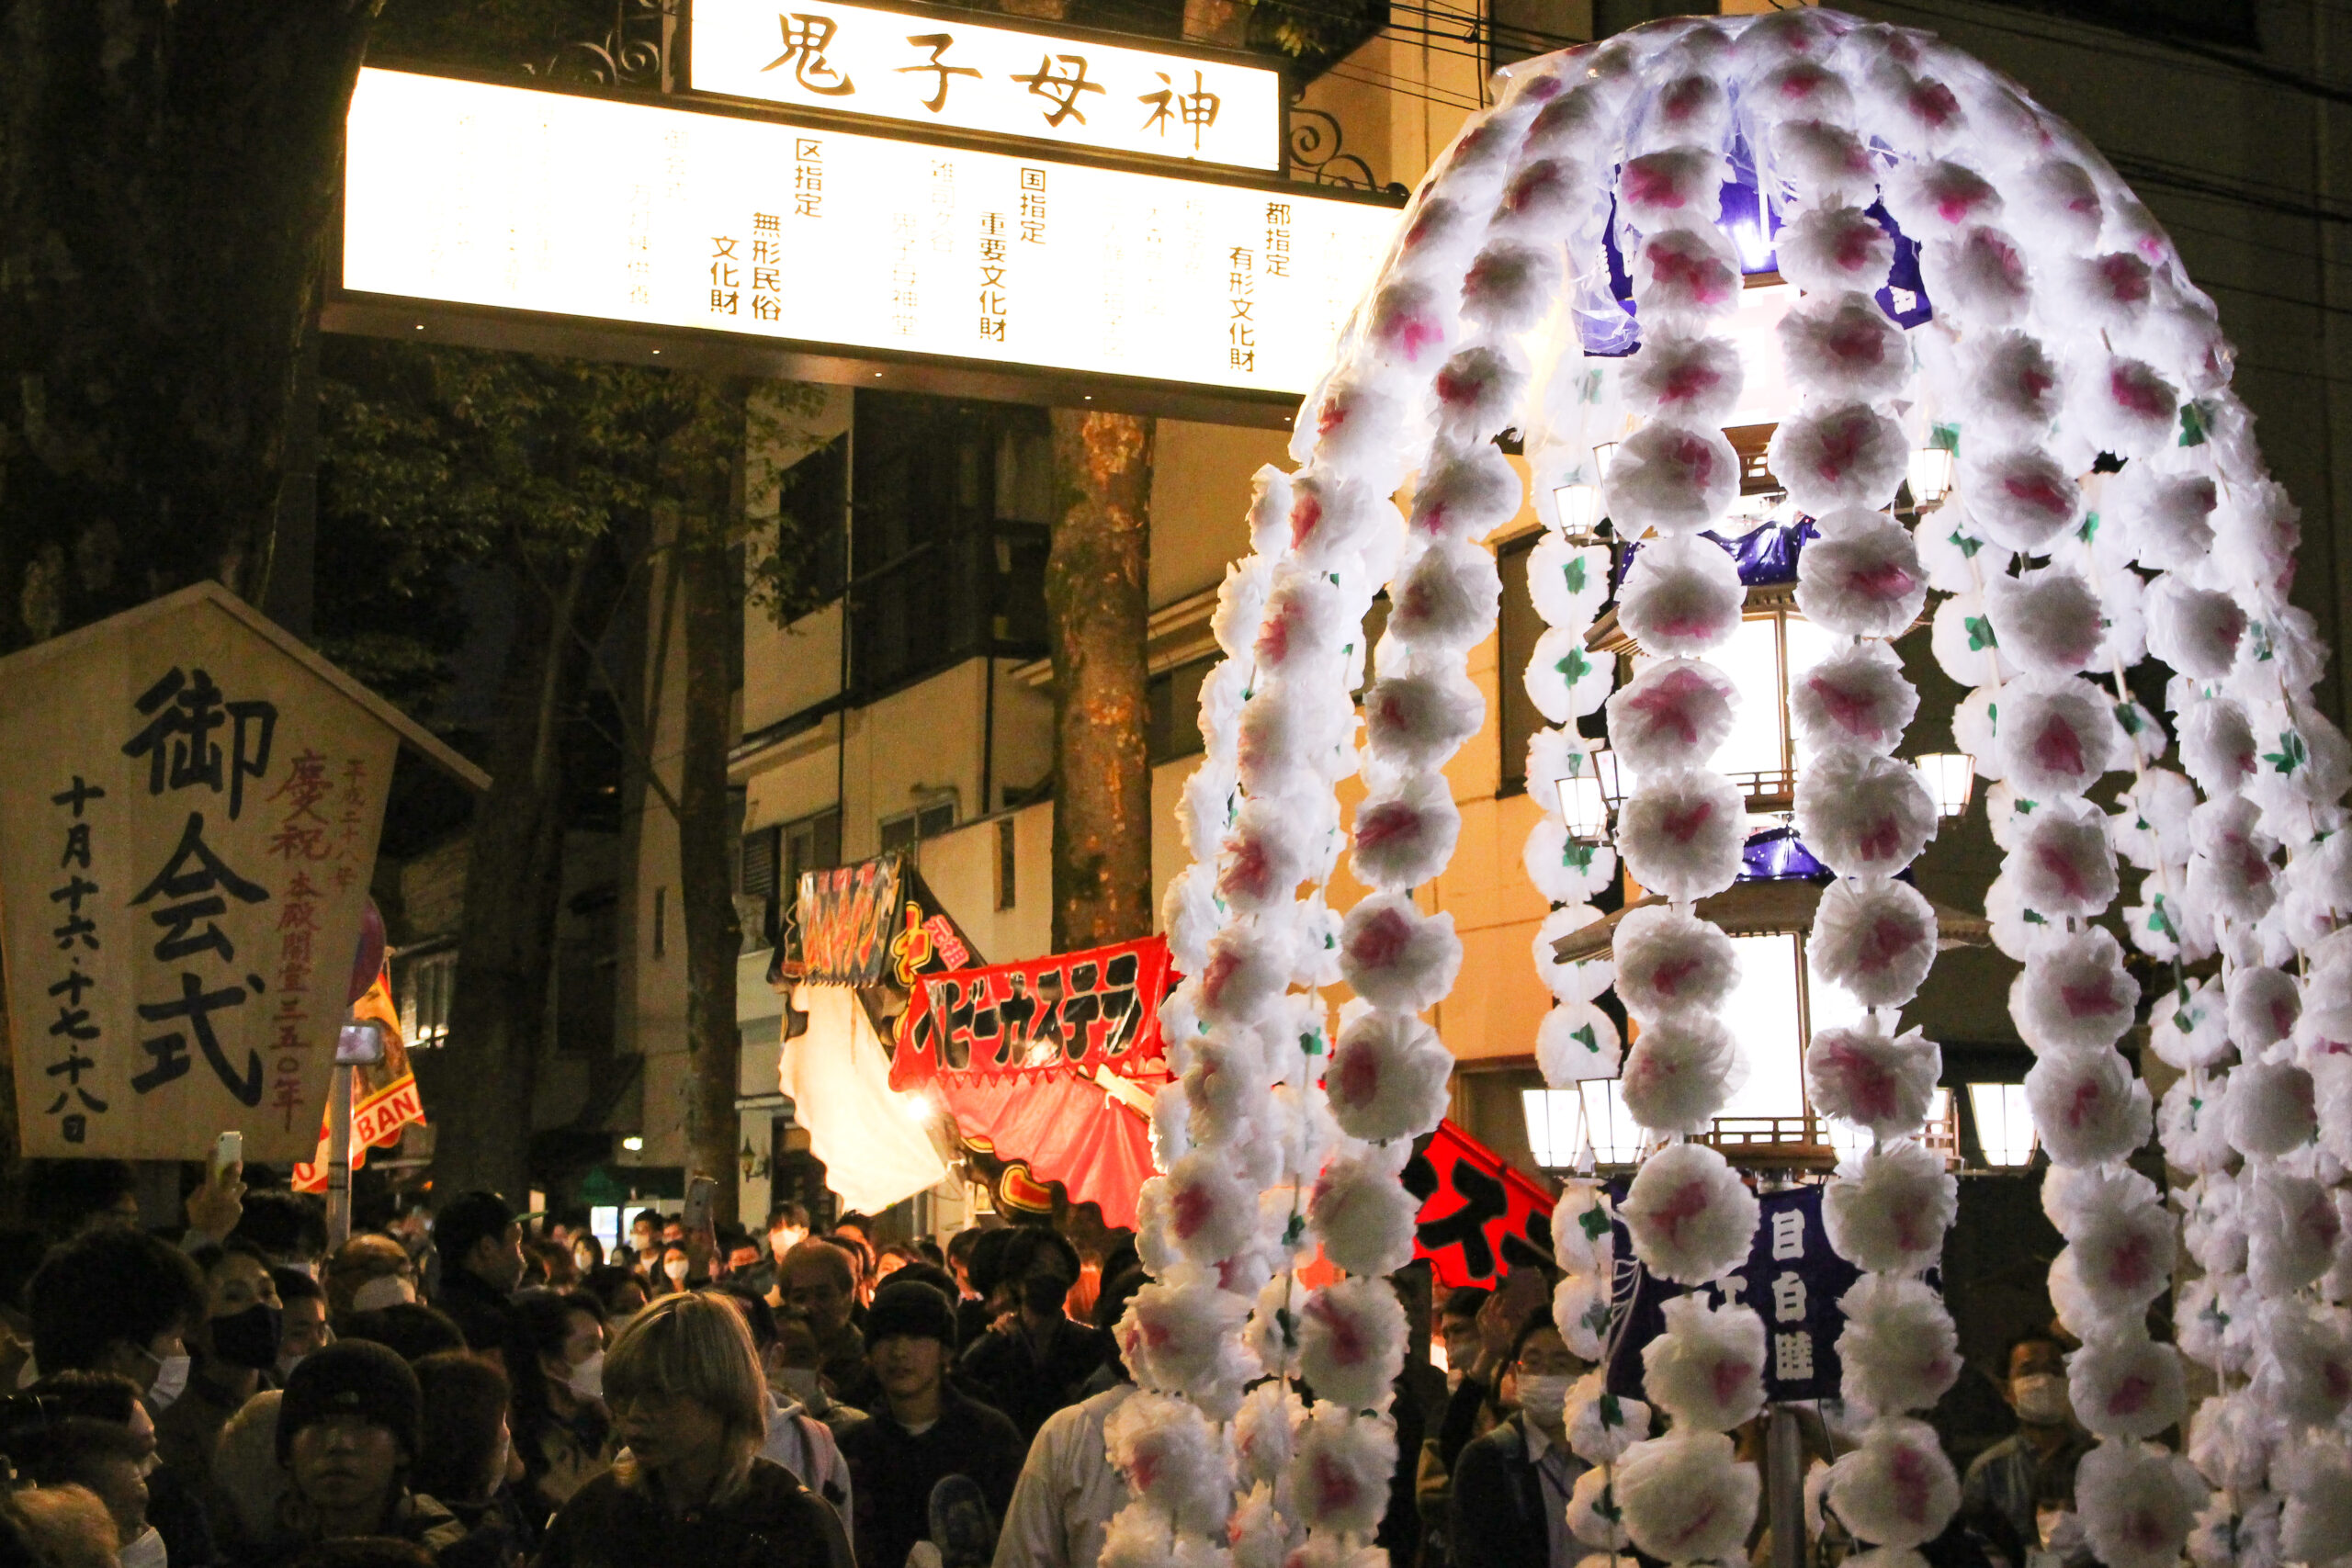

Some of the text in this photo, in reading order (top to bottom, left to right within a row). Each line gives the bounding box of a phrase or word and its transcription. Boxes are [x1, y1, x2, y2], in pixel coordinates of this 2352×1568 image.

[760, 13, 1221, 151] 鬼子母神
[795, 138, 822, 218] 区指定
[1020, 167, 1046, 244] 国指定
[710, 236, 740, 315] 文化財
[752, 212, 781, 321] 無形民俗
[979, 213, 1007, 342] 重要文化財
[1266, 202, 1291, 276] 都指定
[1229, 247, 1255, 372] 有形文化財
[121, 666, 278, 1108] 御会式
